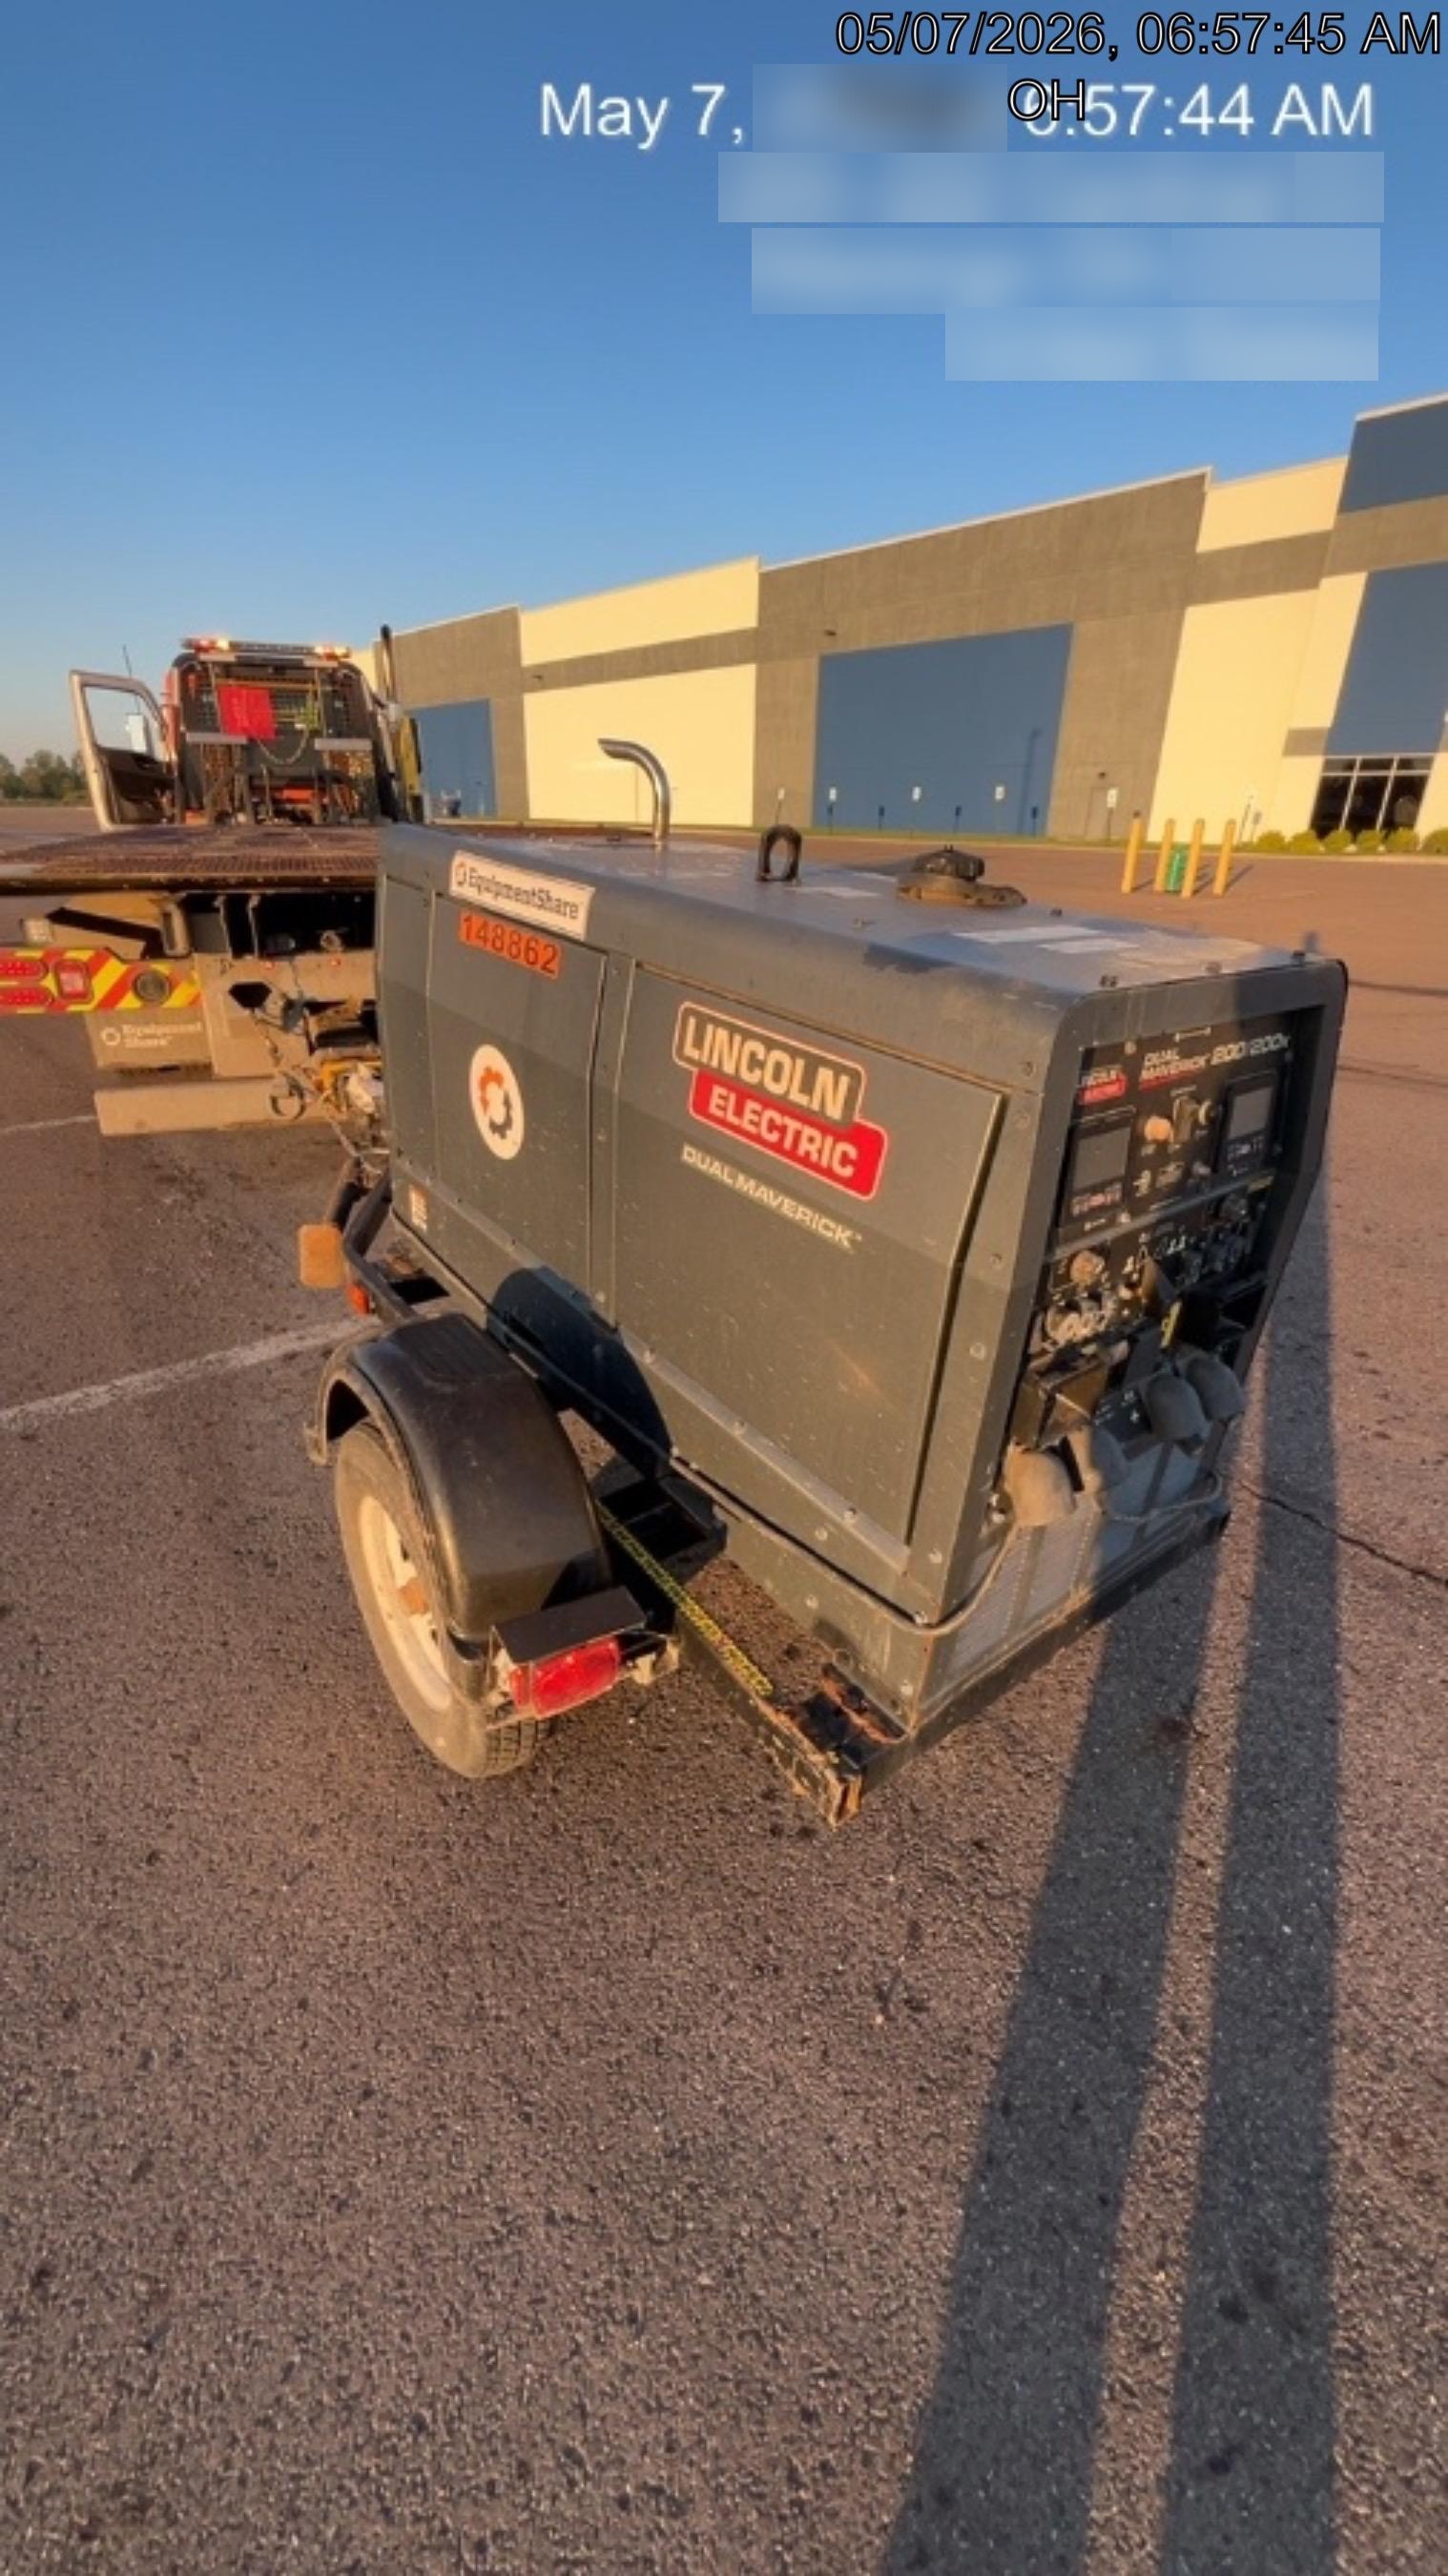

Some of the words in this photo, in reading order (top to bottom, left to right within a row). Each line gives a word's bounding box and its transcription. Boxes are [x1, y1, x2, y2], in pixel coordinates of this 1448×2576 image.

[468, 866, 579, 920] EquipmentShare
[463, 913, 559, 975] 148862
[683, 1014, 849, 1121] LINCOLN
[709, 1083, 858, 1178] ELECTRIC
[681, 1143, 734, 1185] DUAL
[734, 1172, 857, 1250] MAVERICK
